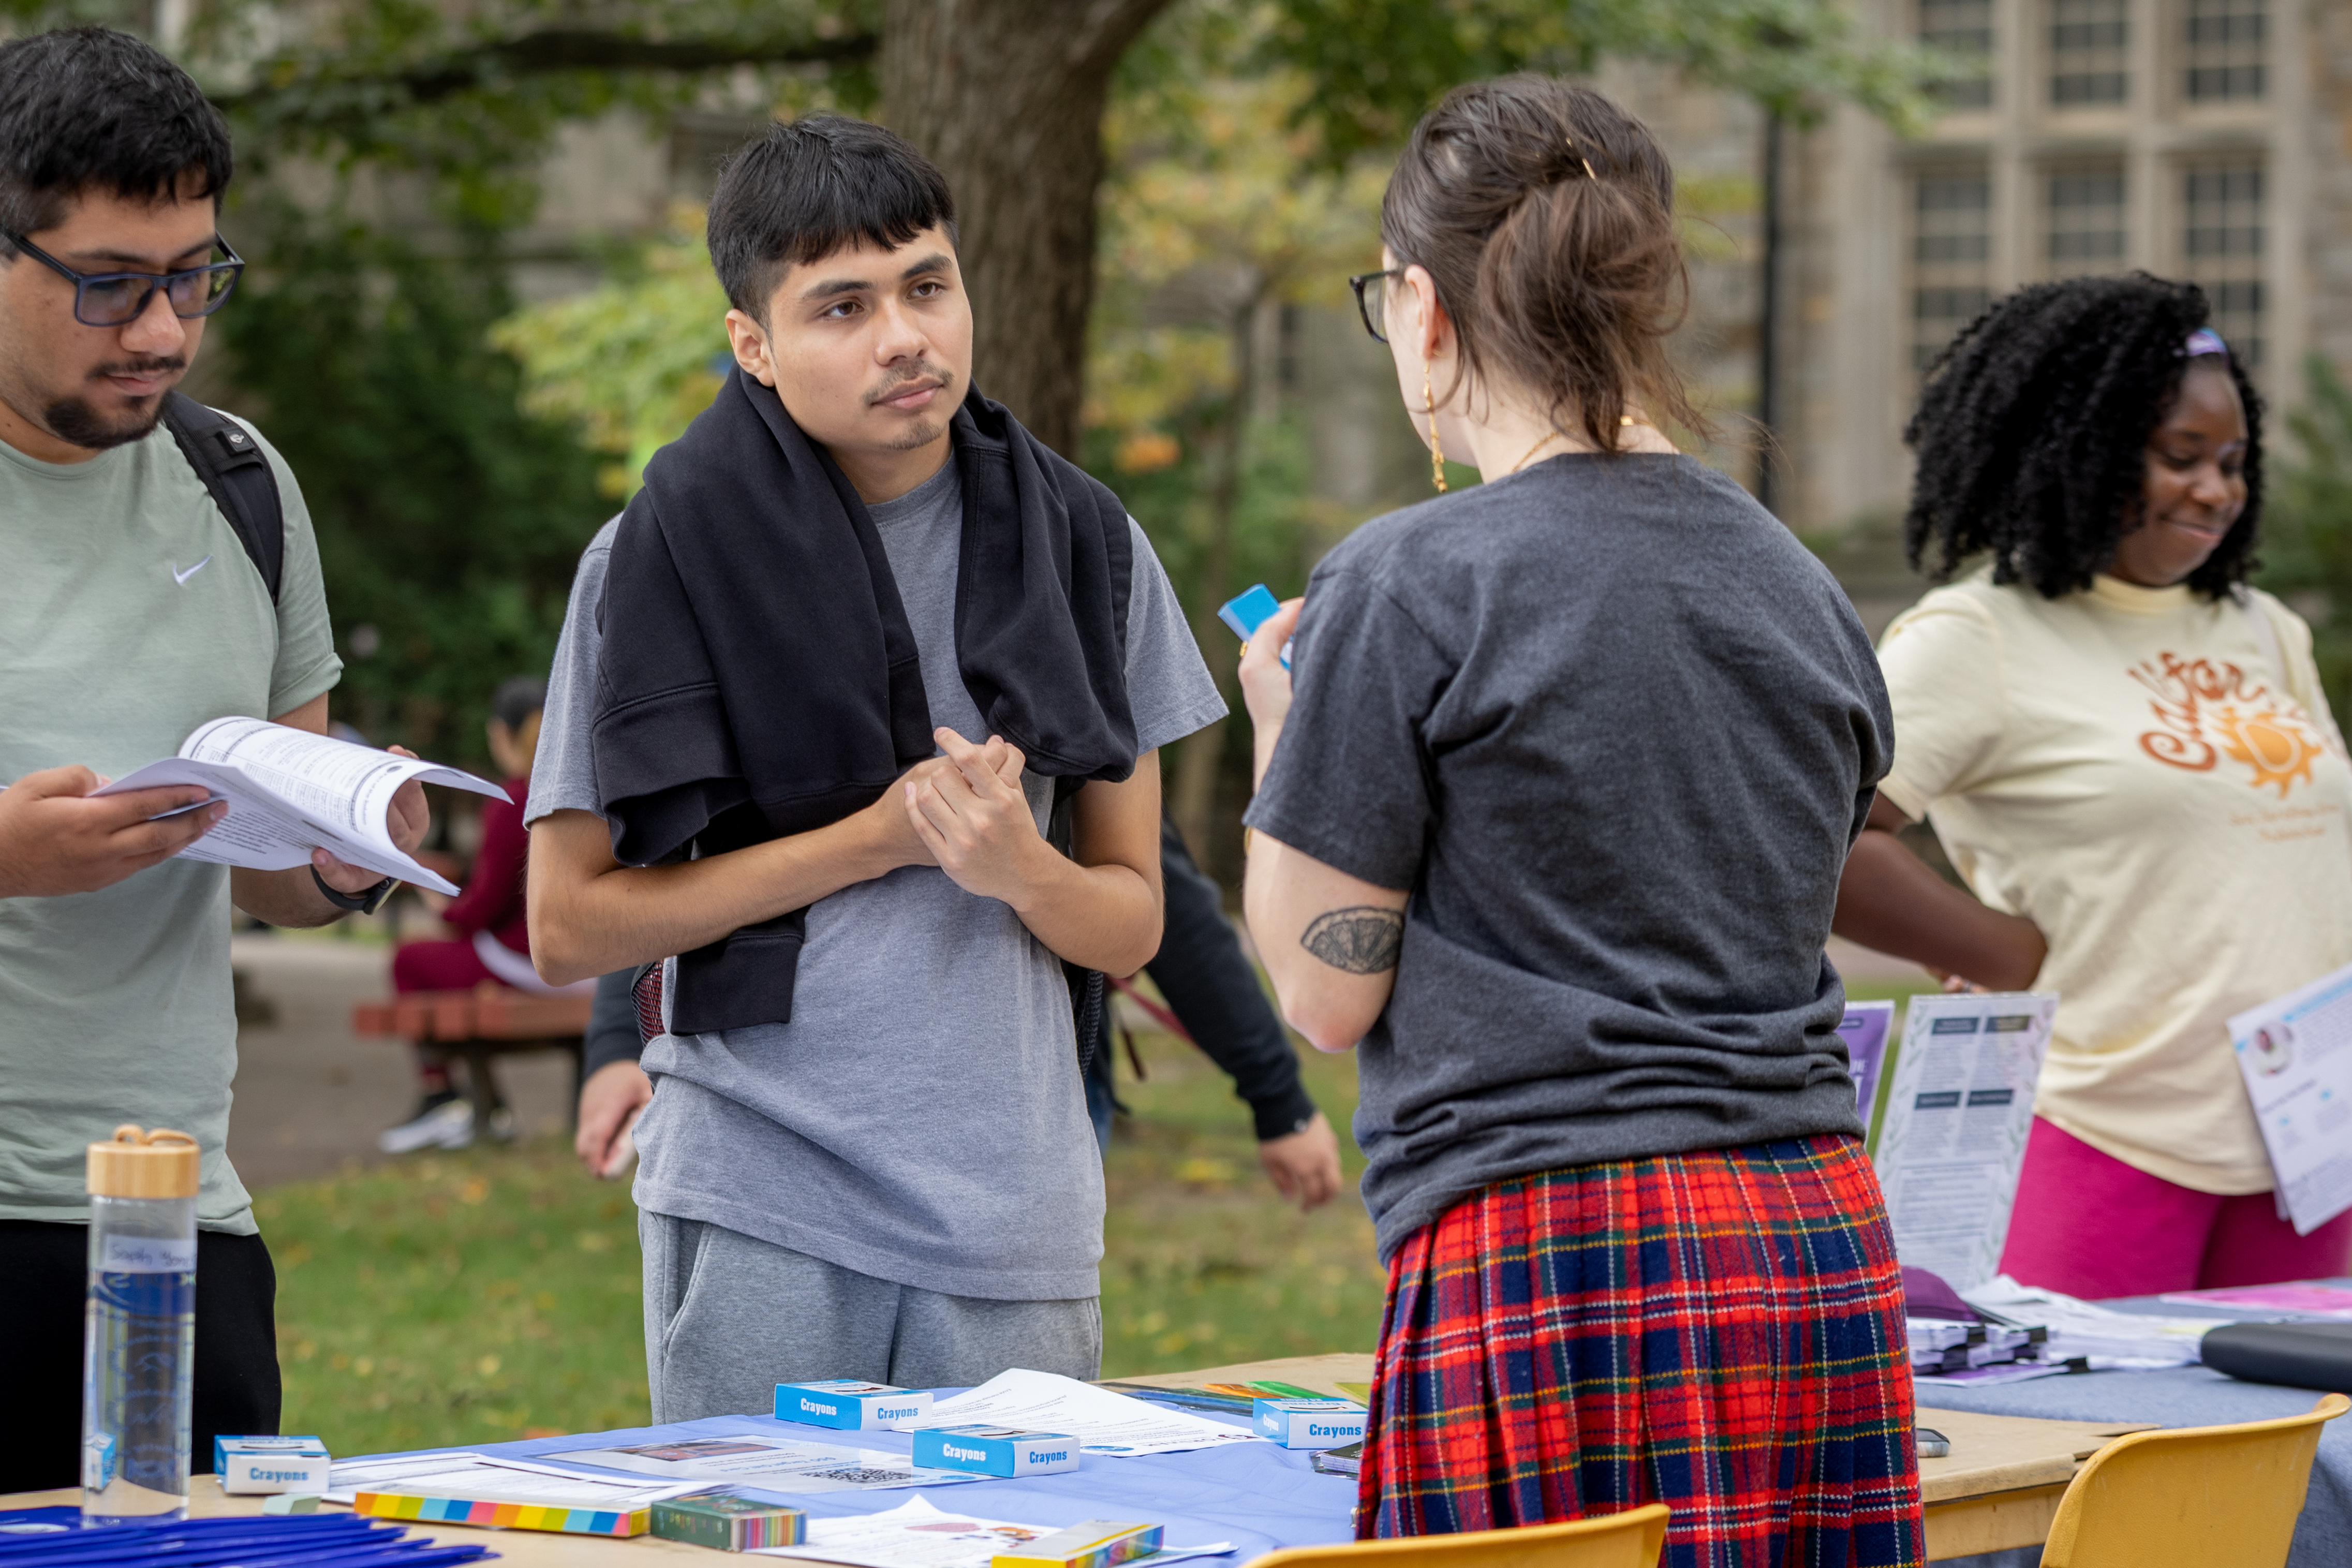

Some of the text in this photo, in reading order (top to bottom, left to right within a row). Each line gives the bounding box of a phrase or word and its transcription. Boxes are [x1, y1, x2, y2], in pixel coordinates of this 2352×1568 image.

[800, 1398, 837, 1417] Crayons
[877, 1407, 919, 1421] Crayons
[1263, 1413, 1279, 1432] Crayons
[1309, 1423, 1363, 1439] Crayons
[943, 1443, 986, 1463] Crayons
[1029, 1449, 1068, 1465] Crayons
[249, 1467, 309, 1482] Crayons
